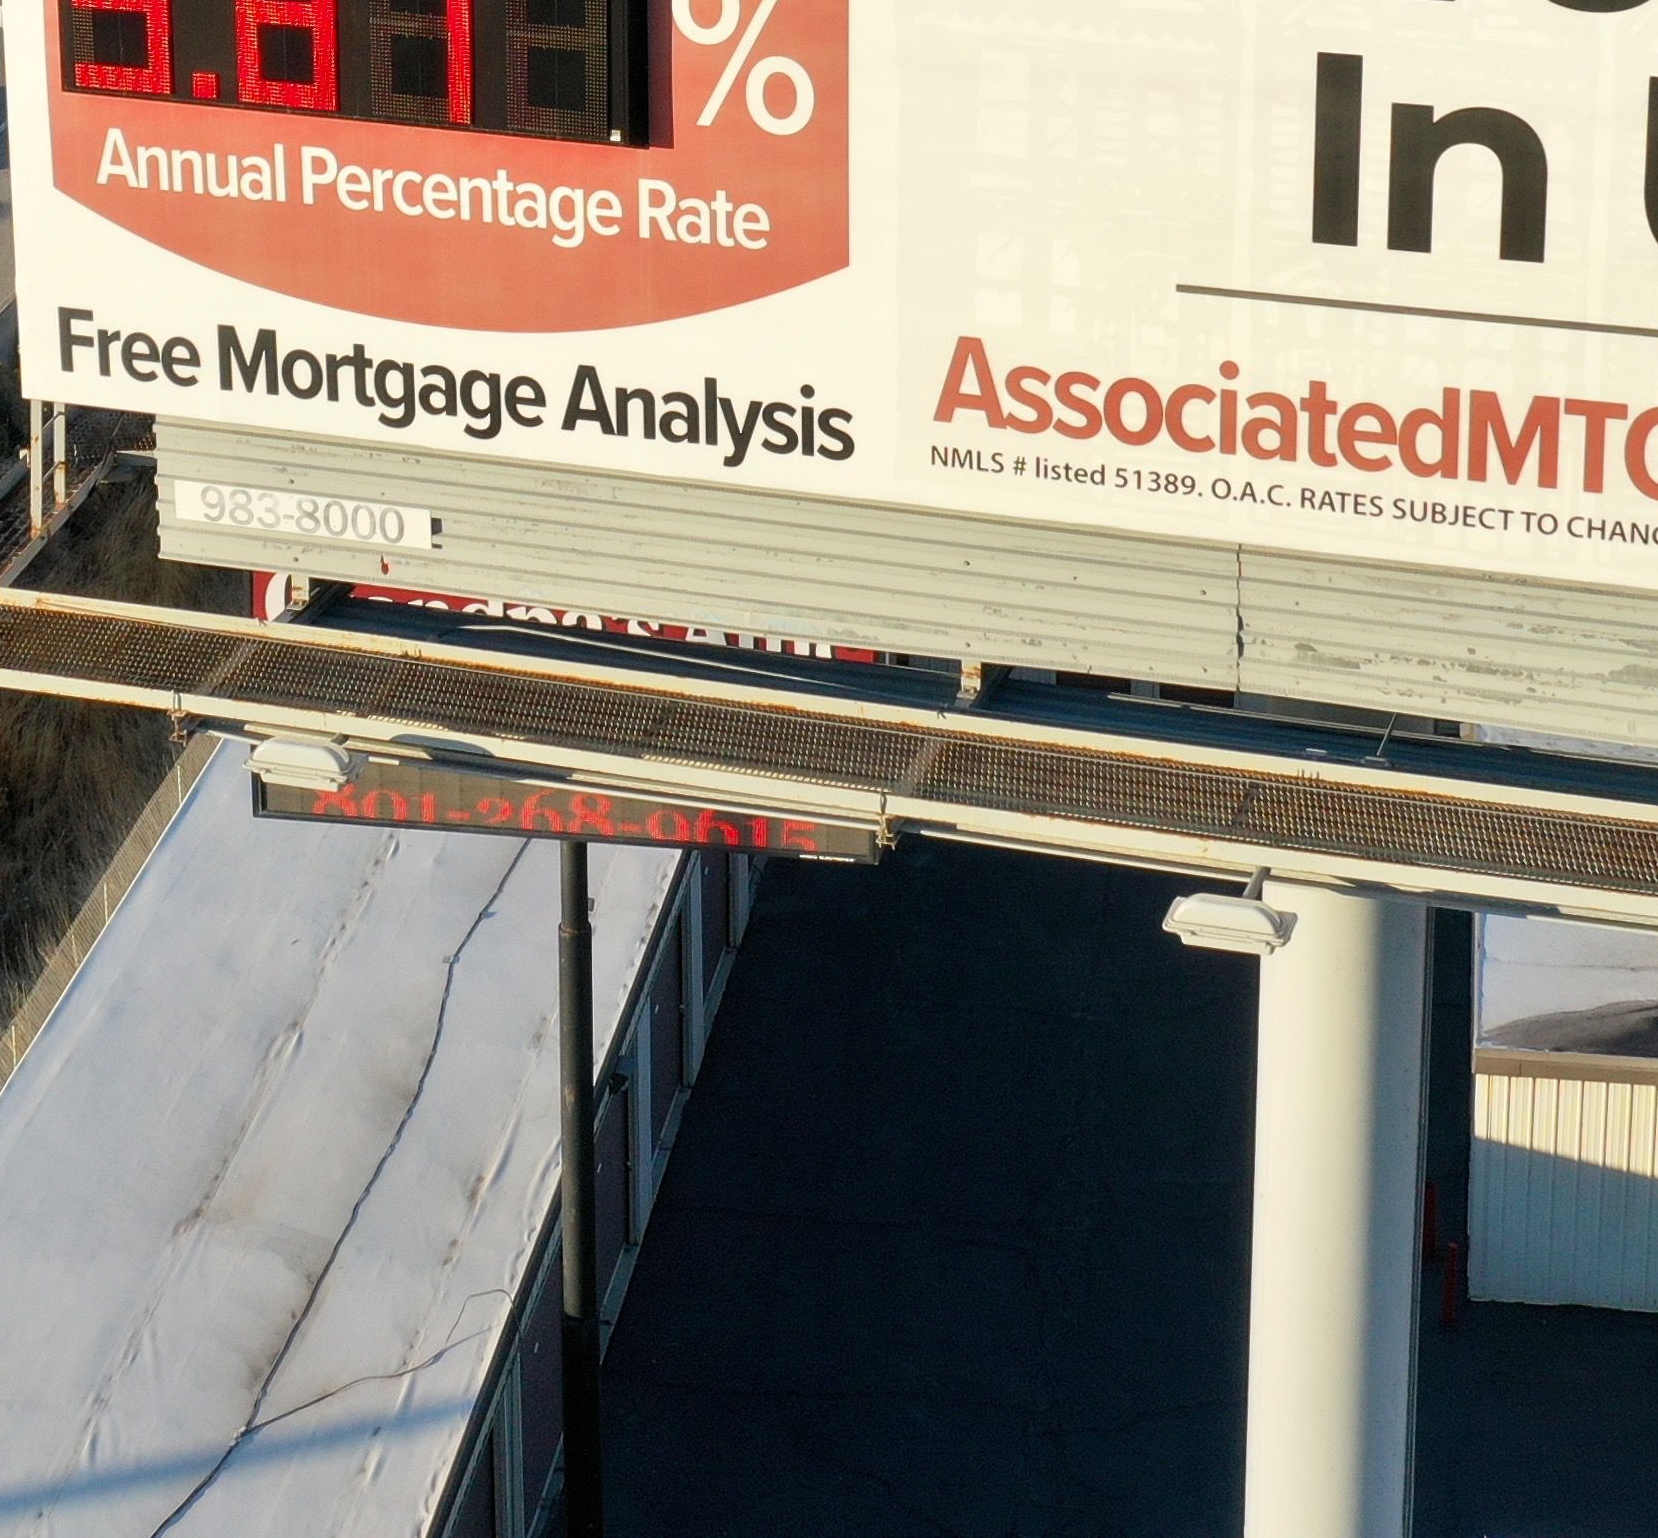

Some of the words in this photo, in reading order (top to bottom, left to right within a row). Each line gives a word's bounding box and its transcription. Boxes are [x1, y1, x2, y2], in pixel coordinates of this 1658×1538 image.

[96, 127, 287, 202] Annual
[301, 157, 623, 248] Percentage
[638, 178, 772, 251] Rate
[1311, 51, 1549, 264] In
[56, 306, 201, 388] Free
[218, 324, 545, 440] Mortgage
[561, 364, 856, 468] Analysis
[200, 485, 405, 544] 983-8000
[930, 445, 1004, 474] NMLS
[1012, 455, 1028, 476] #
[1035, 458, 1106, 486] listed
[1114, 467, 1204, 498] 51389.
[1210, 478, 1292, 508] O.A.C.
[1300, 487, 1384, 517] RATES
[1392, 497, 1514, 533] SUBJECT
[1521, 510, 1558, 536] TO
